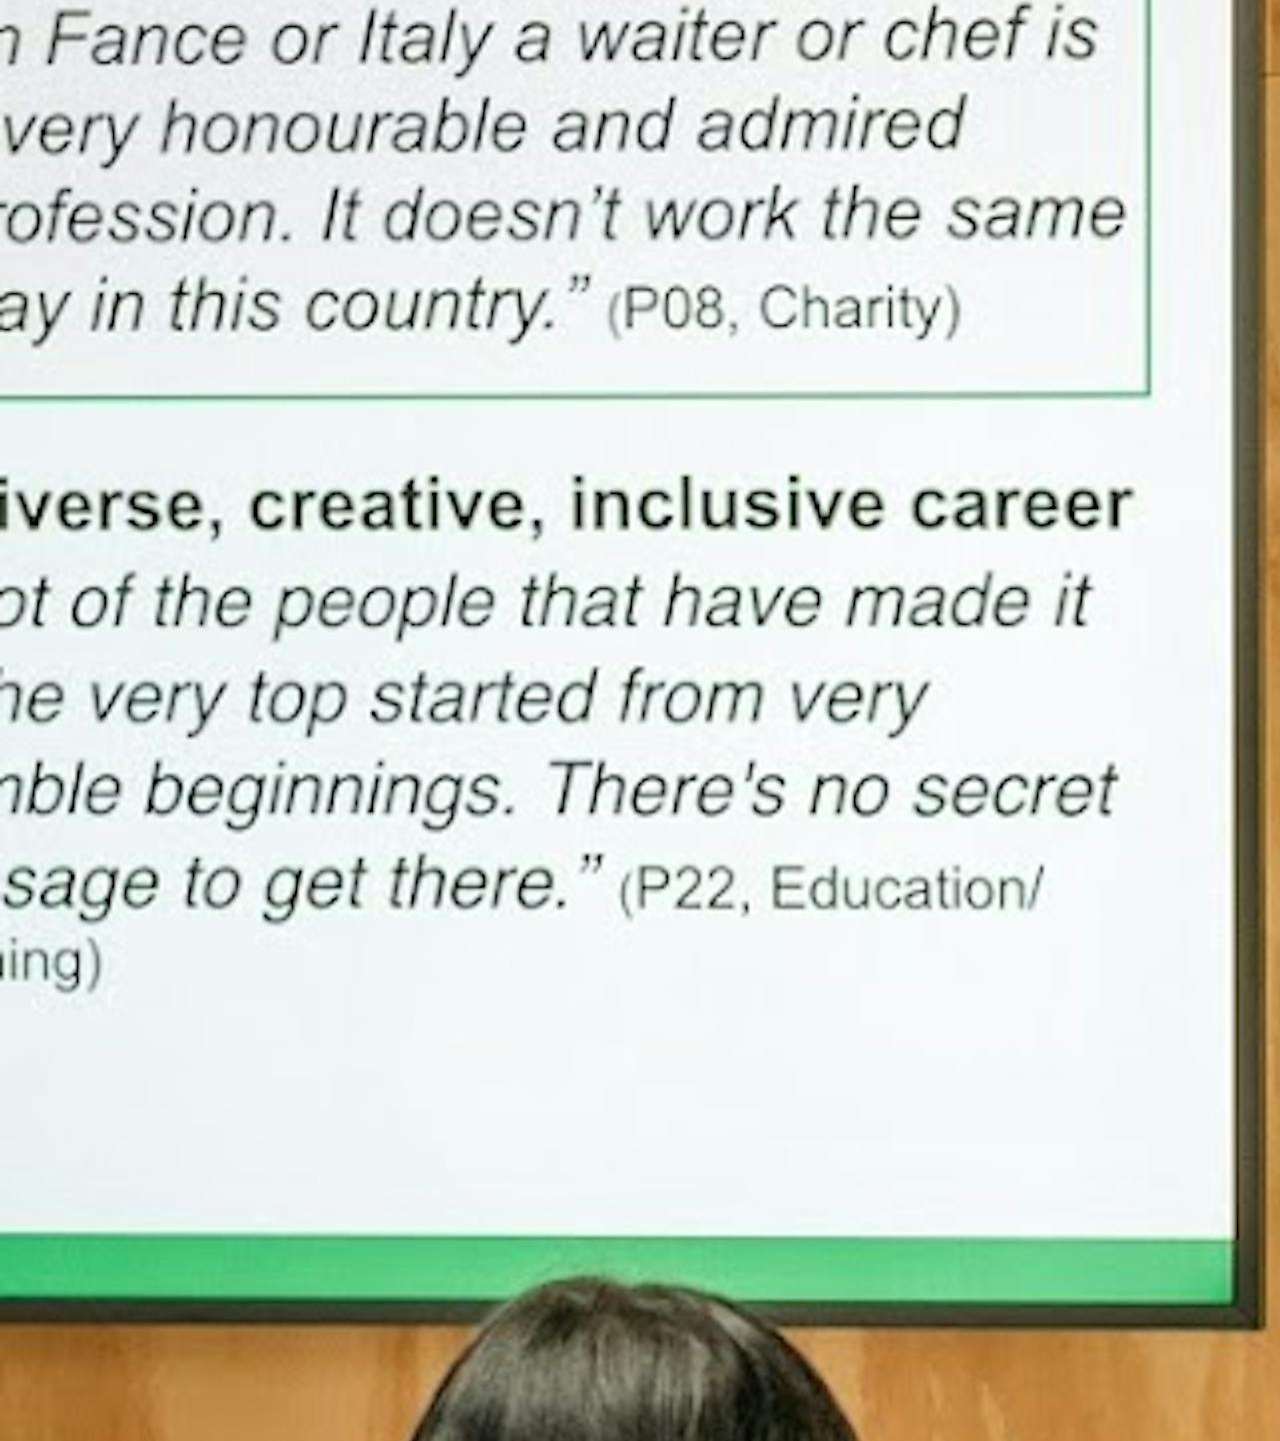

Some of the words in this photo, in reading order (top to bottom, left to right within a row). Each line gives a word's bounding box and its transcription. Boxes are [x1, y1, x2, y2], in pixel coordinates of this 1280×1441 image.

[44, 8, 248, 67] Fance
[270, 21, 341, 66] or
[357, 6, 495, 80] Italy
[513, 19, 551, 64] a
[578, 5, 779, 63] waiter
[795, 17, 867, 62] or
[883, 1, 1033, 62] chef
[1045, 2, 1099, 61] is
[2, 111, 141, 170] very
[158, 94, 527, 155] honourable
[551, 94, 678, 153] and
[695, 91, 968, 153] admired
[0, 185, 291, 245] ofession.
[321, 184, 362, 242] It
[382, 183, 622, 242] doesn’t
[645, 182, 799, 241] work
[822, 182, 922, 241] the
[945, 195, 1127, 240] same
[89, 273, 145, 332] in
[168, 273, 281, 333] this
[304, 272, 592, 346] country.”
[608, 283, 738, 337] (P08,
[758, 282, 961, 341] Charity)
[248, 473, 544, 541] creative,
[571, 472, 885, 531] inclusive
[910, 486, 1135, 531] career
[69, 569, 137, 629] of
[153, 570, 253, 629] the
[270, 571, 496, 643] people
[520, 570, 645, 628] that
[662, 570, 823, 628] have
[844, 569, 1031, 628] made
[1053, 569, 1094, 628] it
[90, 679, 228, 739] very
[248, 669, 348, 739] top
[368, 665, 599, 725] started
[618, 664, 764, 724] from
[790, 679, 931, 740] very
[142, 758, 514, 833] beginnings.
[548, 758, 787, 818] There's
[807, 772, 897, 818] no
[911, 762, 1120, 818] secret
[1, 864, 160, 925] sage
[183, 855, 245, 910] to
[260, 855, 369, 926] get
[388, 851, 605, 910] there.”
[619, 863, 750, 918] (P22,
[771, 863, 1045, 910] Education/
[0, 935, 107, 994] ing)
